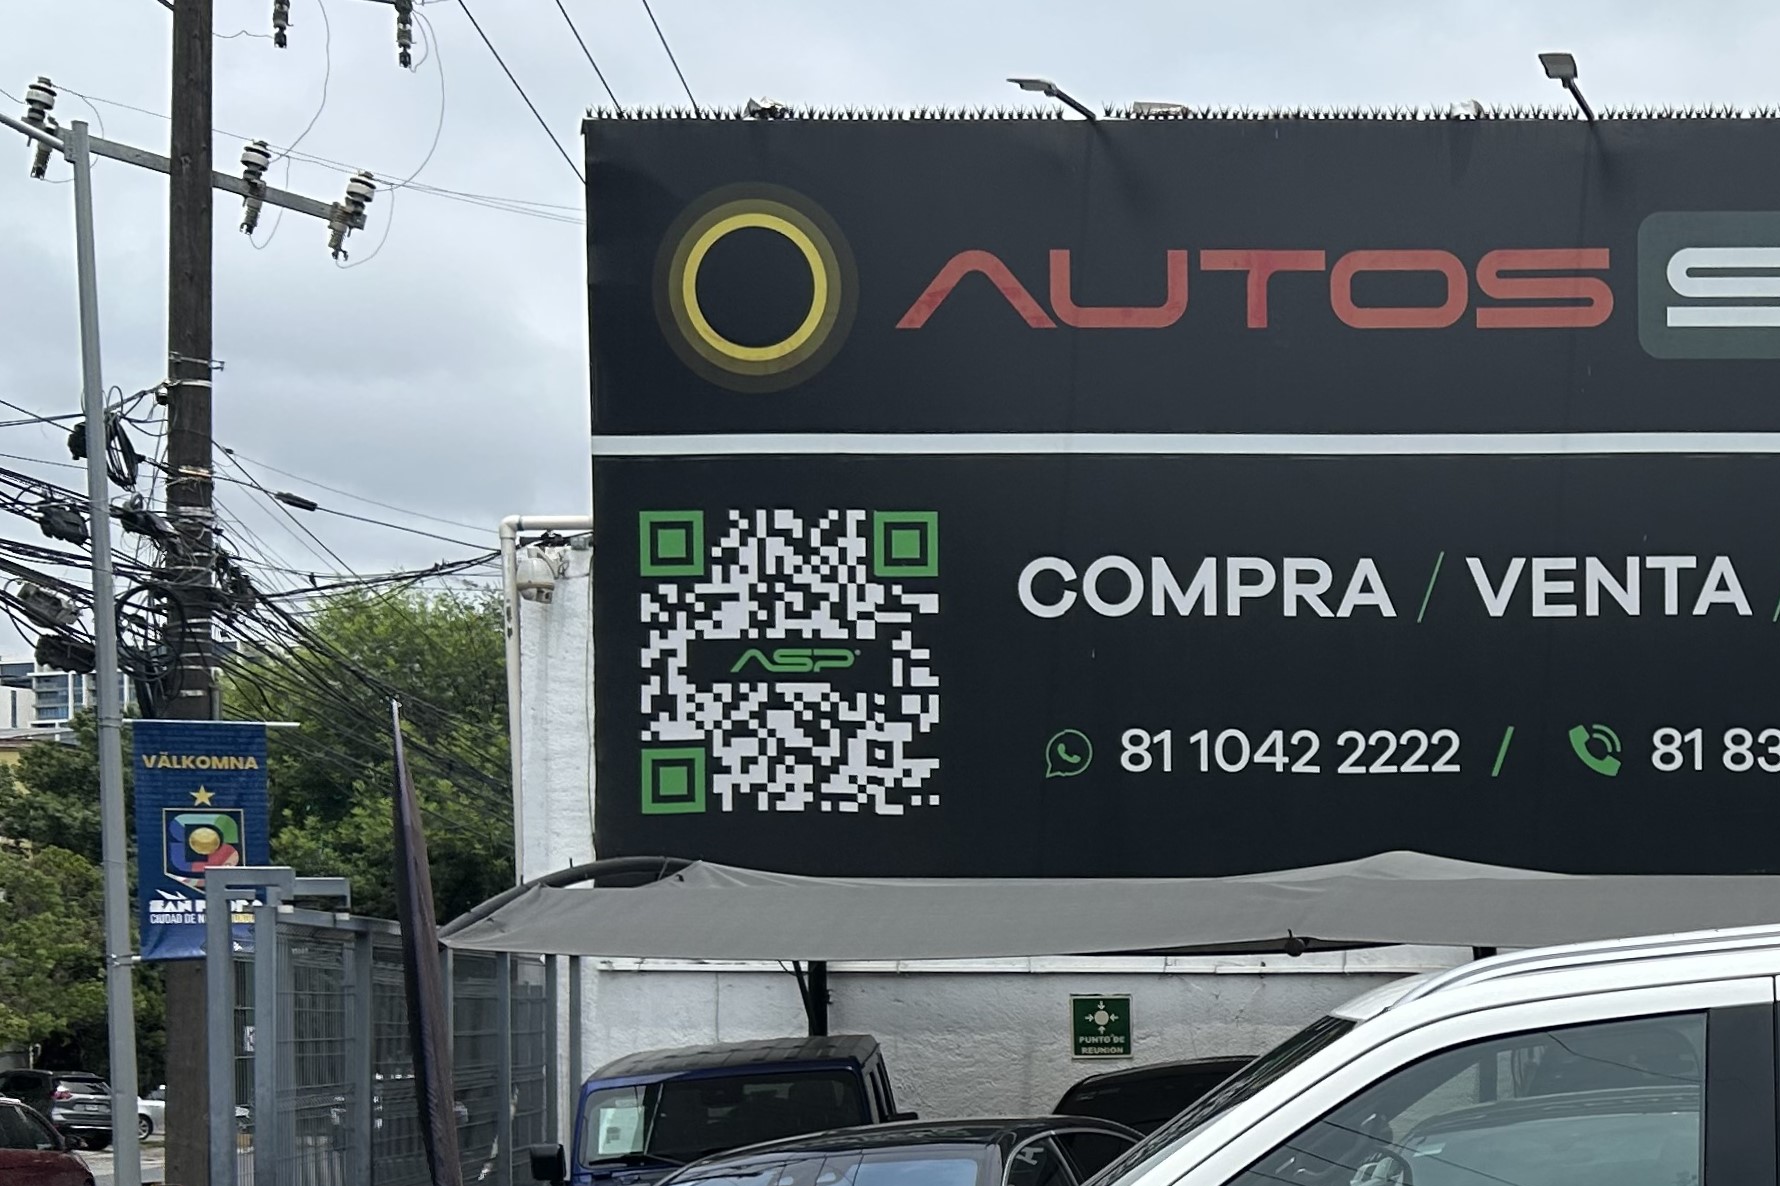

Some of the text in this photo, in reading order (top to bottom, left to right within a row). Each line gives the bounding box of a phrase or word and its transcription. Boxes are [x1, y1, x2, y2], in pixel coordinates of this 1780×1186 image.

[896, 249, 1614, 329] AUTOS
[1018, 555, 1397, 618] COMPRA
[1465, 555, 1753, 617] VENTA
[730, 648, 855, 673] ASP
[142, 751, 259, 770] VÄLKOMNA
[1120, 728, 1172, 772] 81
[1189, 728, 1321, 773] 1042
[1337, 729, 1461, 774] 2222
[1652, 727, 1703, 771] 81
[1079, 1035, 1126, 1044] PUNTO DE
